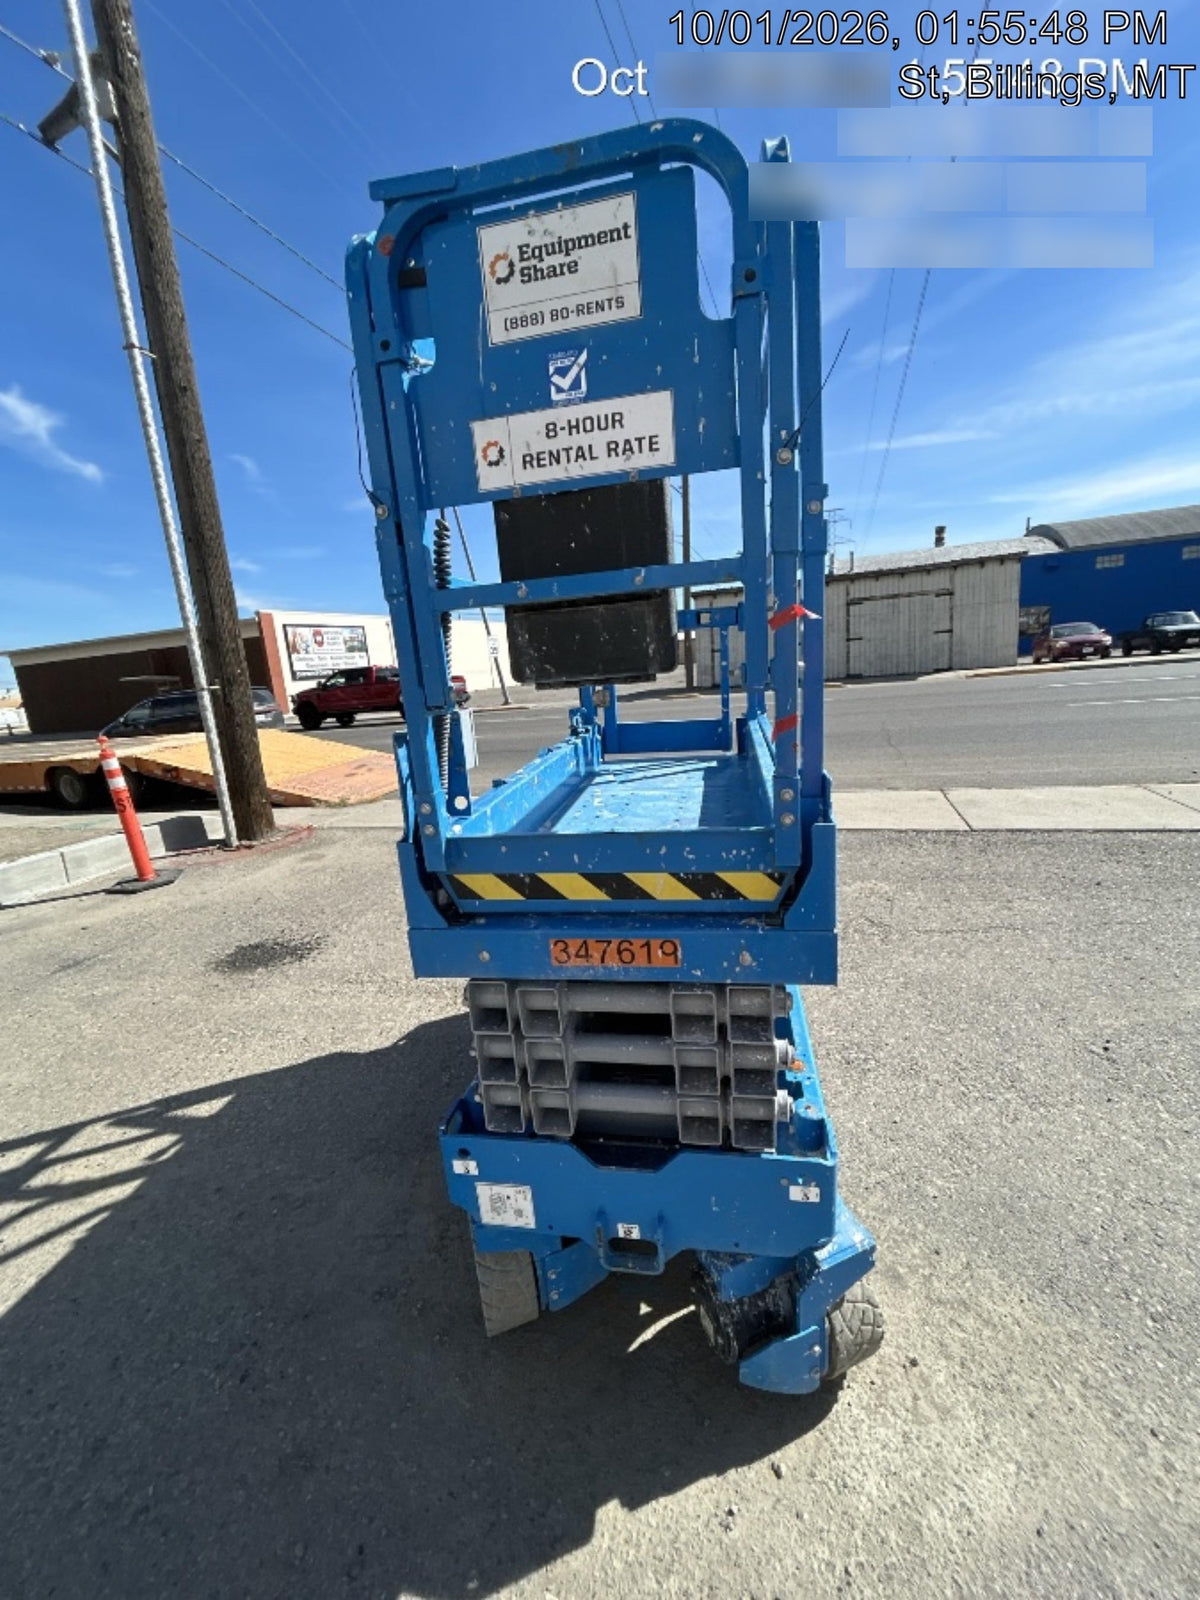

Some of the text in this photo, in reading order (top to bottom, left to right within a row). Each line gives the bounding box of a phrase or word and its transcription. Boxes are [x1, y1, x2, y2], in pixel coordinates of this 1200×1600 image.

[517, 222, 632, 264] Equipment
[519, 259, 580, 285] Share
[504, 310, 545, 333] (888)
[544, 411, 625, 440] 8-HOUR
[521, 434, 661, 471] RENTAL RATE
[552, 938, 679, 965] 347619
